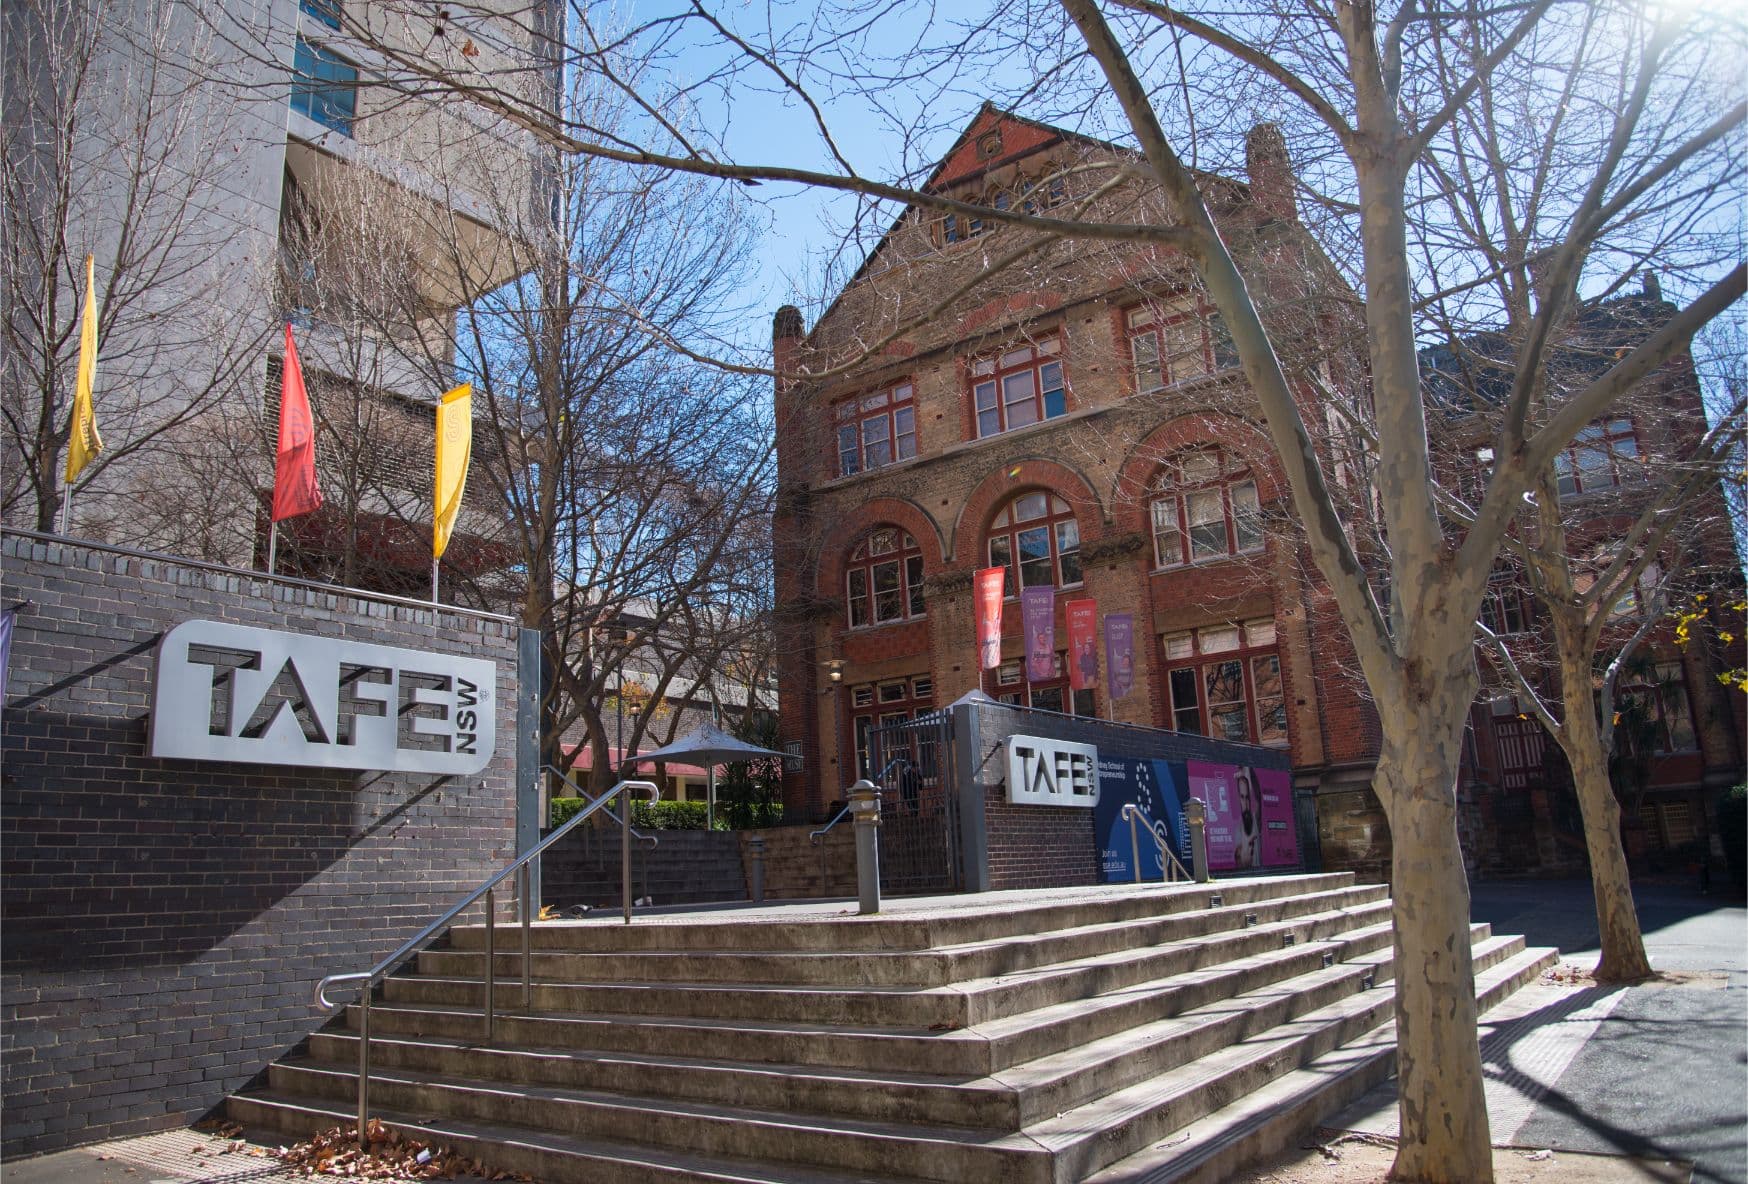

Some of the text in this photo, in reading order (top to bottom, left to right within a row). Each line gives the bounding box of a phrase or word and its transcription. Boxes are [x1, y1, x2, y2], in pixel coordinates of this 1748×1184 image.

[187, 643, 452, 753] TAFE
[456, 677, 478, 755] NSW
[1016, 746, 1088, 796] TAFE
[1086, 755, 1096, 796] NSW
